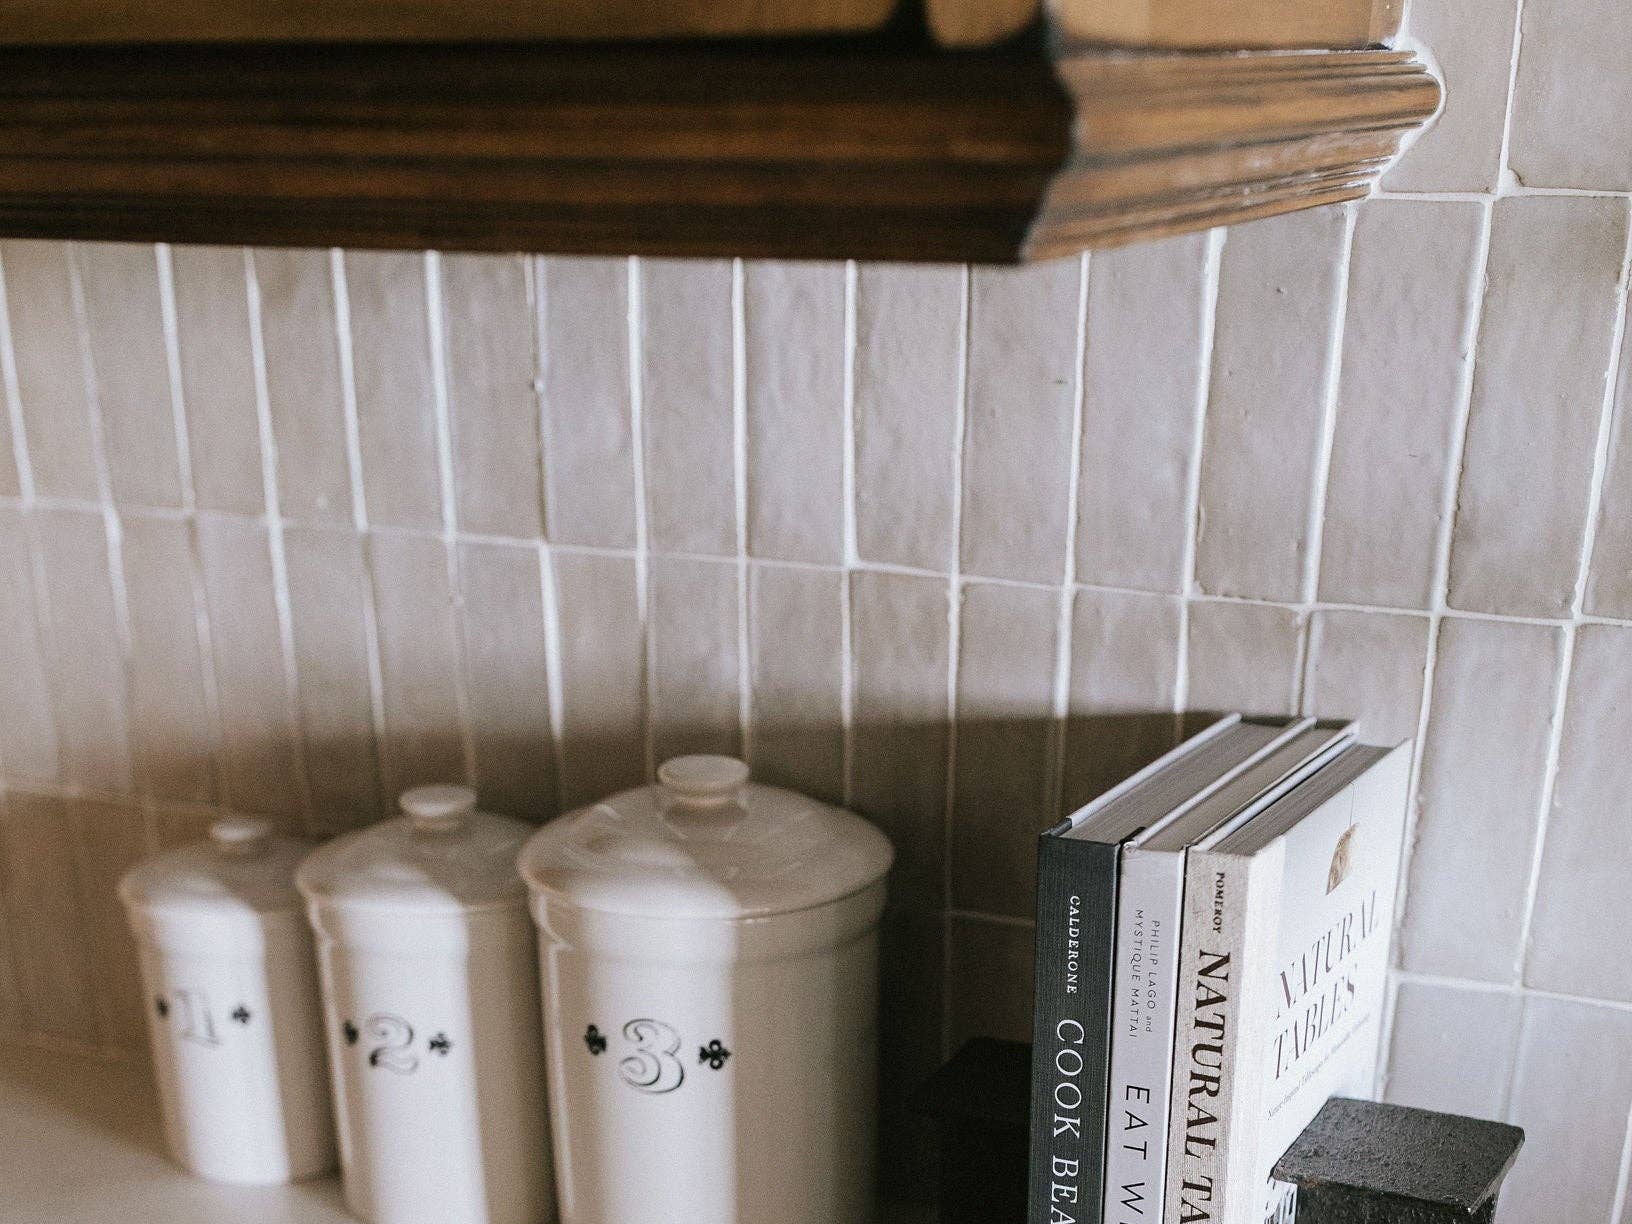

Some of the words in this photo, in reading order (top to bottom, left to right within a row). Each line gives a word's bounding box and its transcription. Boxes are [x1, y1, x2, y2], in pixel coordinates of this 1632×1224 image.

[1212, 872, 1226, 934] POMEROY
[1066, 895, 1081, 994] CALDERONE
[1130, 909, 1144, 982] MYSTIQUE
[1149, 920, 1160, 965] PHILIP
[1129, 984, 1141, 1038] MATTAI
[1147, 967, 1158, 1010] LAGO
[363, 1013, 419, 1075] 2
[618, 1018, 685, 1094] 3
[1145, 1016, 1153, 1033] and
[1183, 948, 1231, 1160] NATURAL
[1053, 1018, 1085, 1139] COOK
[1123, 1084, 1150, 1161] EAT
